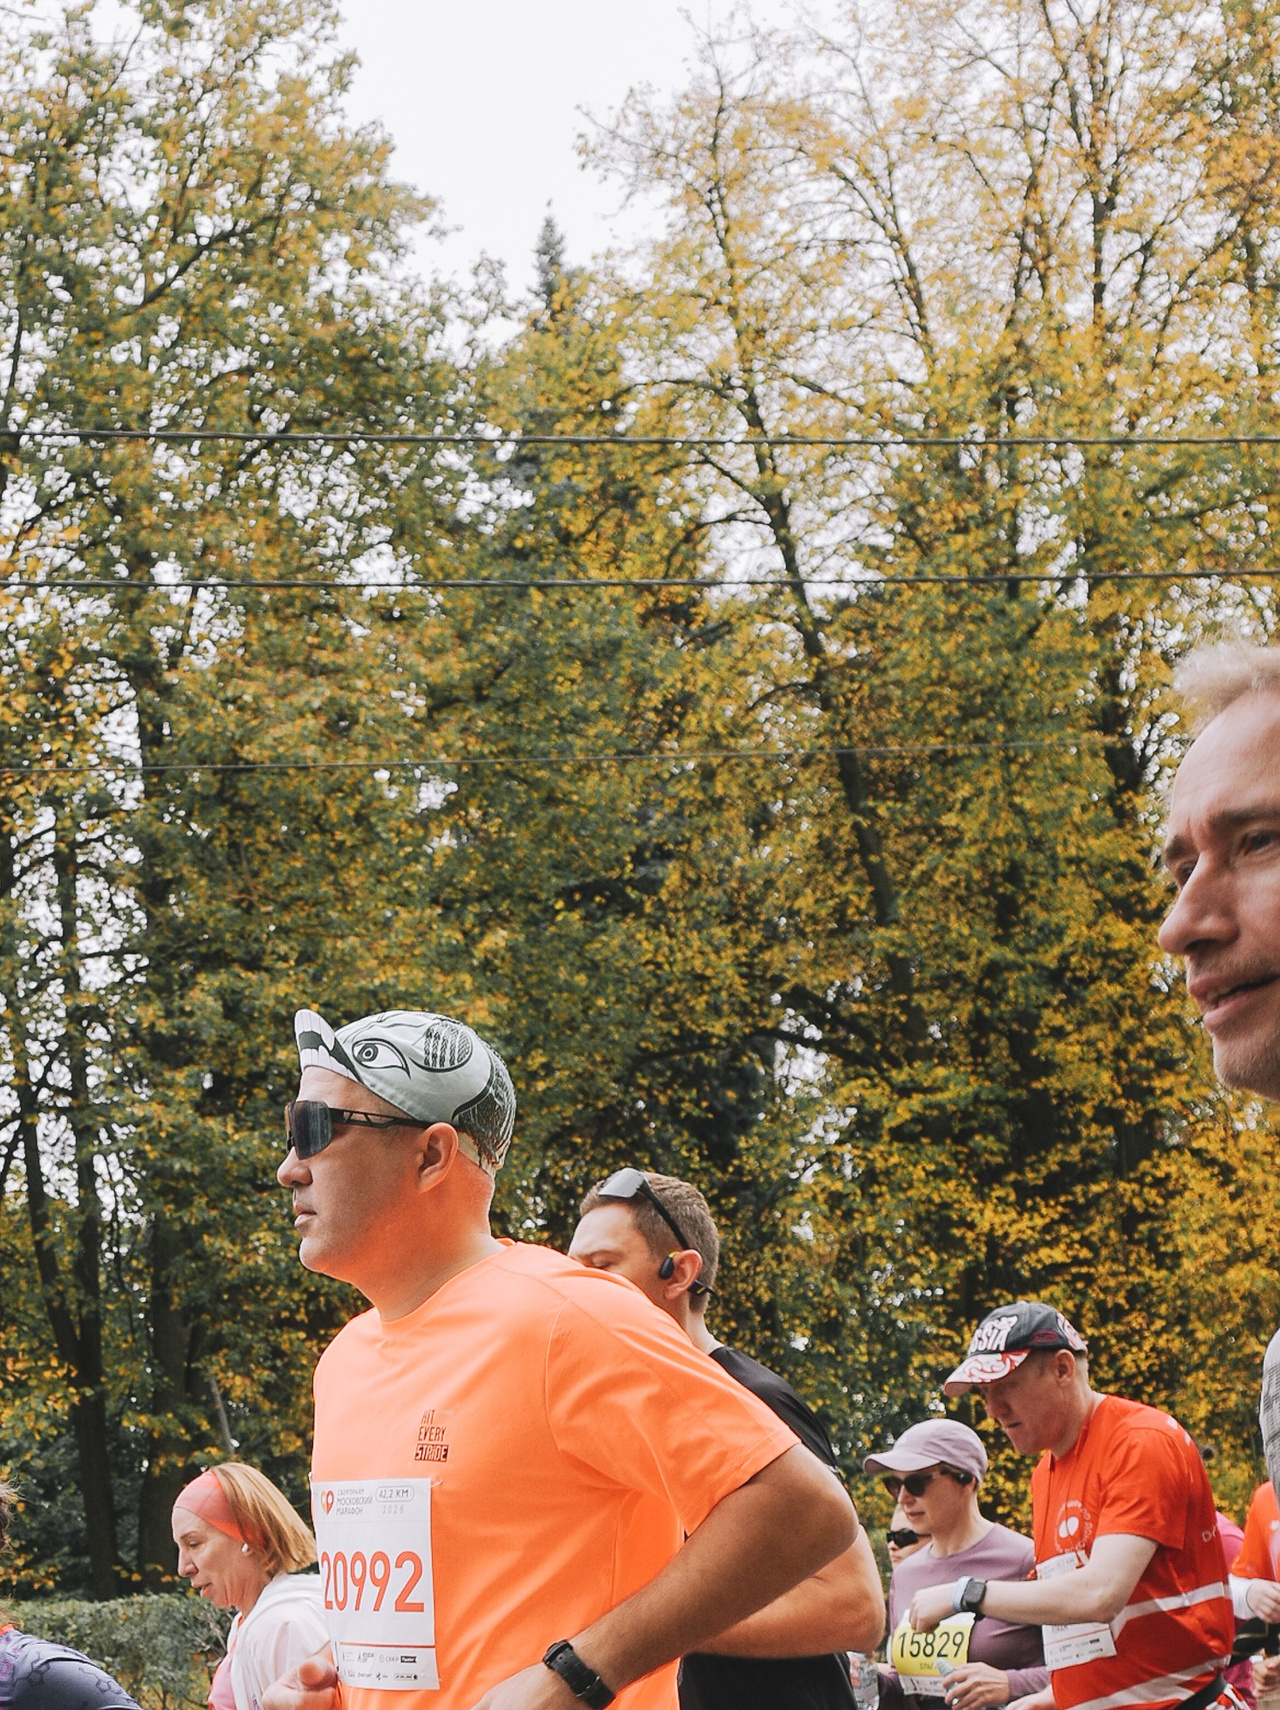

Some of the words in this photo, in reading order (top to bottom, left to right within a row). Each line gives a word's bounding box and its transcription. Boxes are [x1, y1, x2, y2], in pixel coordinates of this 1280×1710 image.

[417, 1426, 447, 1442] EVERY
[321, 1550, 425, 1613] 20992
[898, 1631, 965, 1658] 15829
